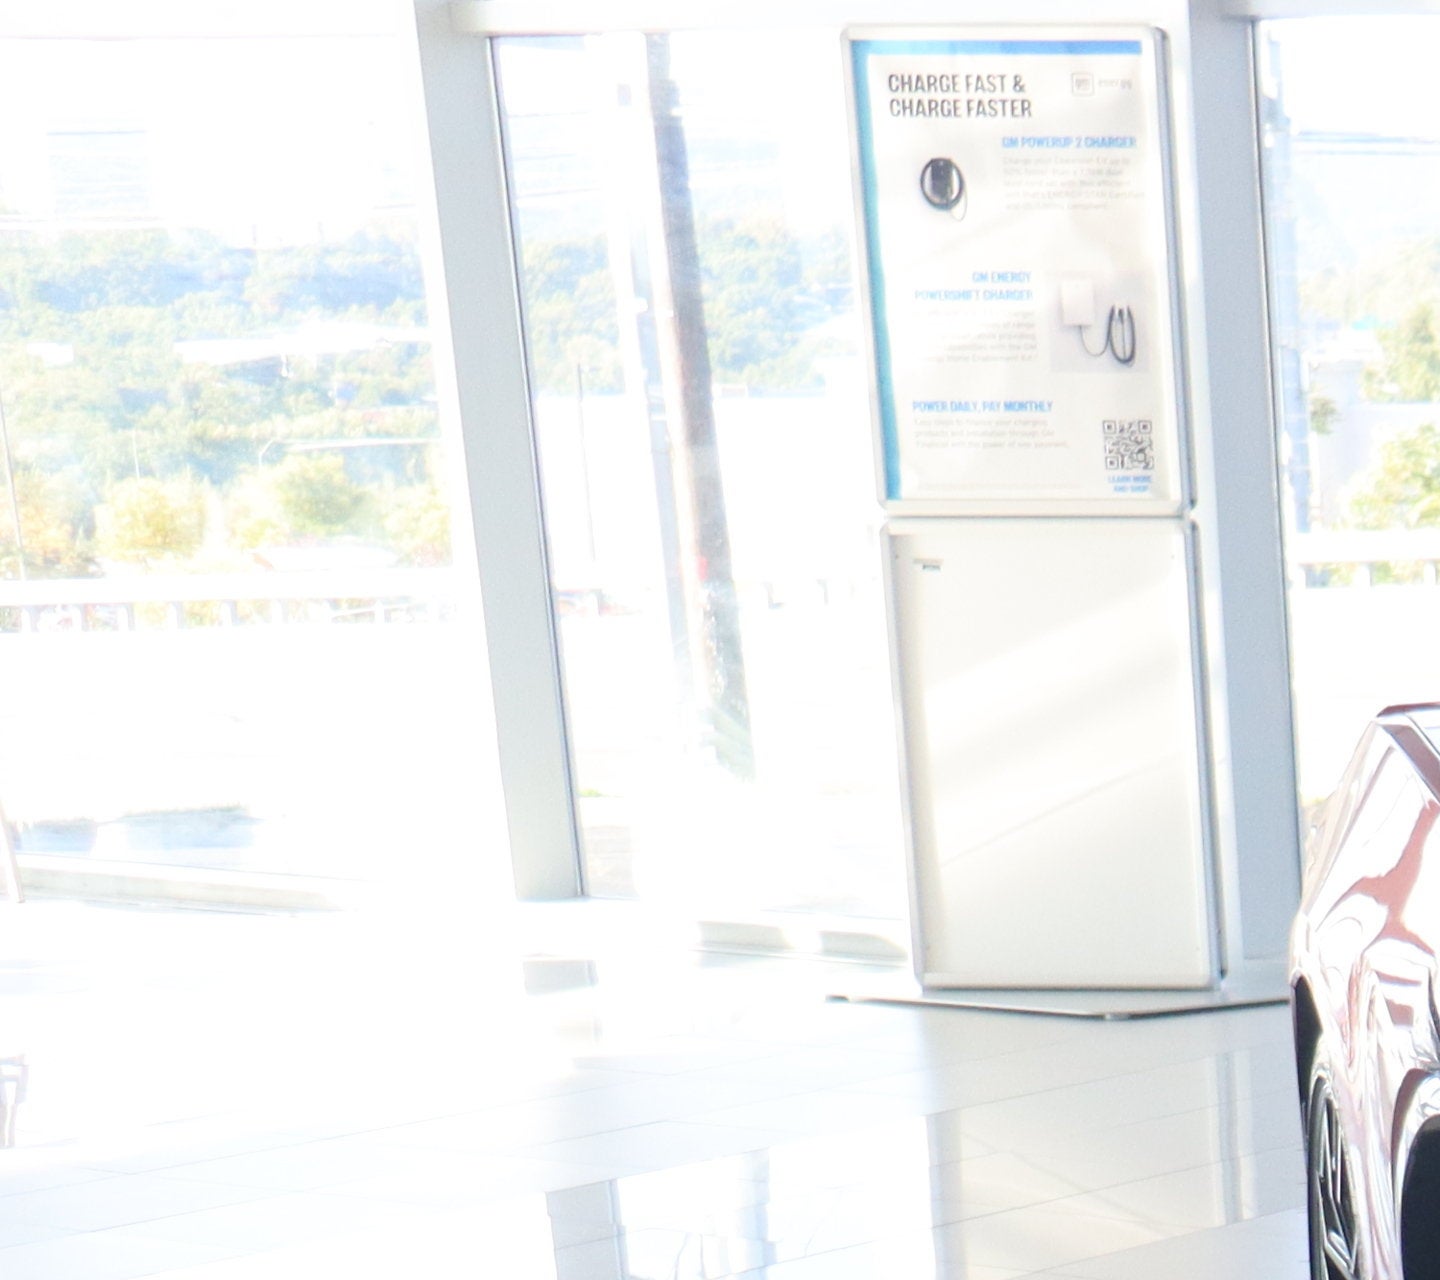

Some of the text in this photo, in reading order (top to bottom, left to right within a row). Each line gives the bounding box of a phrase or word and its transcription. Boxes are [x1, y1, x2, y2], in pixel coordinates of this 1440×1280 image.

[888, 73, 1026, 95] CHARGE FAST &
[889, 97, 1032, 119] CHARGE FASTER
